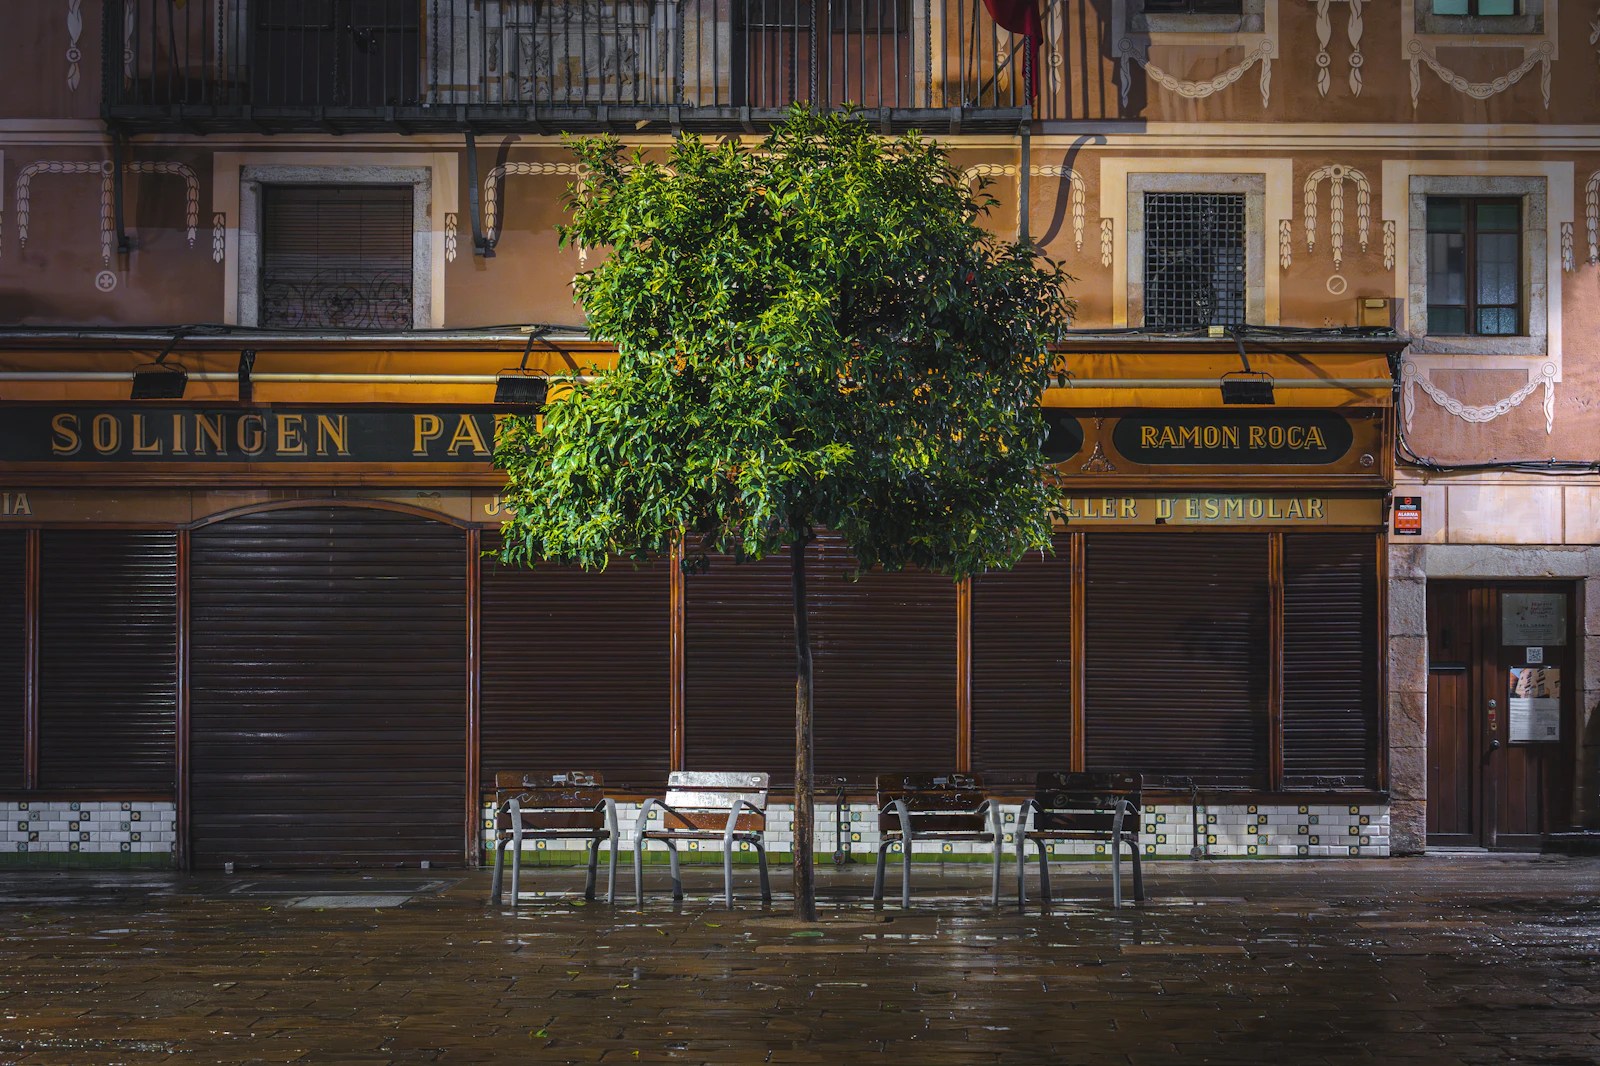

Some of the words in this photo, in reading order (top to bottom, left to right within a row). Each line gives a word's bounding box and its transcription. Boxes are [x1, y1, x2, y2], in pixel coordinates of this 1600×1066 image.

[51, 413, 351, 456] SOLINGEN
[1140, 425, 1240, 449] RAMON
[1249, 425, 1327, 450] ROCA
[1064, 496, 1138, 520] LLER
[1155, 497, 1325, 521] D'ESMOLAR
